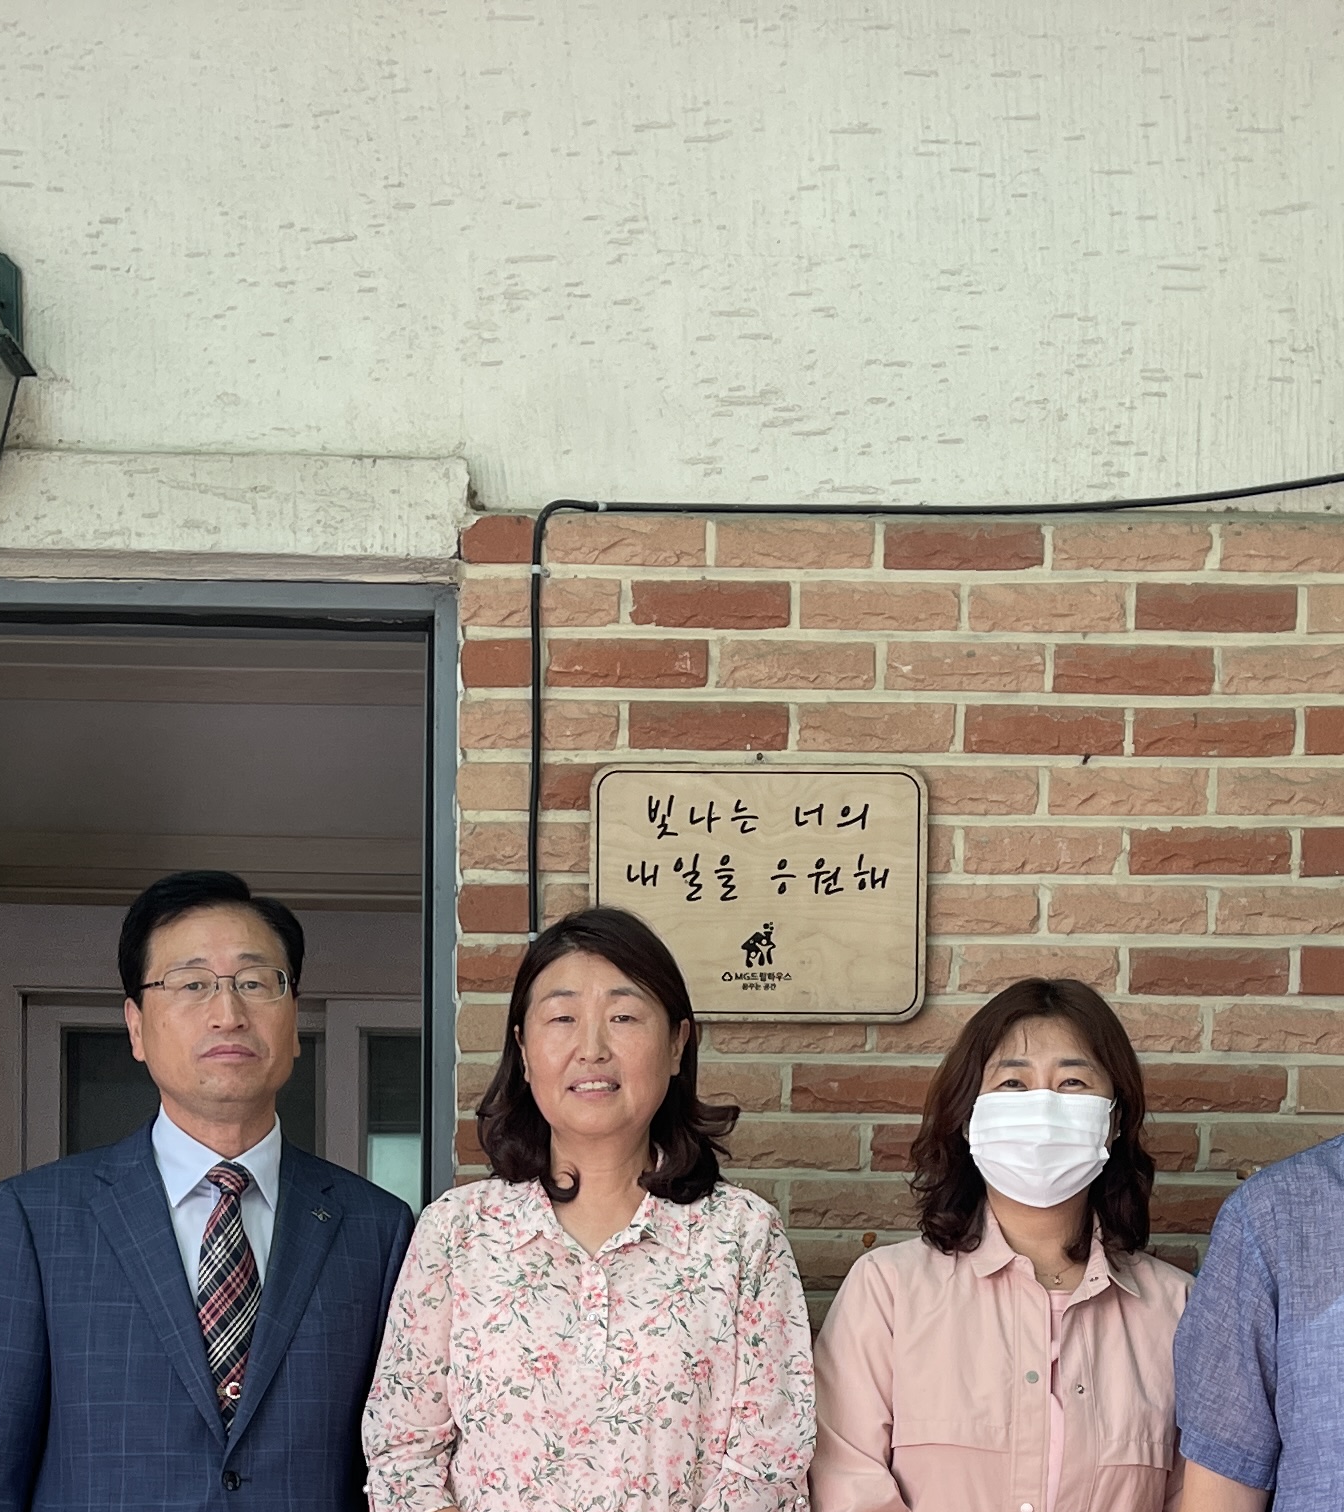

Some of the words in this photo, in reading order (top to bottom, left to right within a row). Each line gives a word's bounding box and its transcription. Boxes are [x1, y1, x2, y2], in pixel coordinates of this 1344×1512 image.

[647, 794, 760, 840] 빛나는
[794, 803, 870, 831] 너의
[626, 852, 739, 902] 내일을
[770, 853, 890, 896] 응원해
